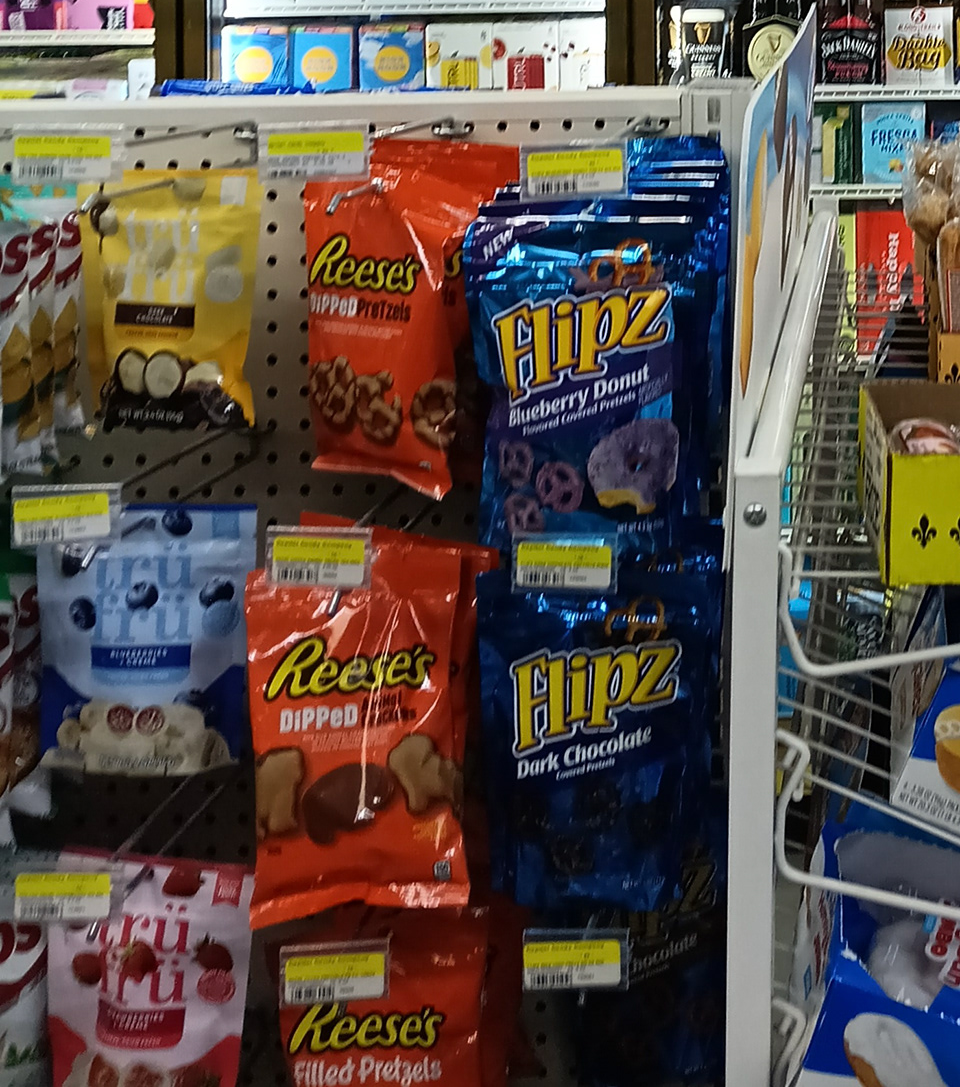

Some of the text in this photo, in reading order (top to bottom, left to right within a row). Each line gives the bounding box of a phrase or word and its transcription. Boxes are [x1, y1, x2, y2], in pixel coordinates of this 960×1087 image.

[870, 127, 918, 147] FRESCA
[309, 233, 421, 294] Reese's
[483, 226, 515, 262] NEW
[492, 284, 672, 404] Flipz
[508, 363, 650, 428] Blueberry Donut
[522, 390, 636, 437] Flavored Covered Pretzels
[264, 634, 435, 702] Reese's
[511, 640, 682, 757] Flipz
[517, 726, 652, 780] Dark Chocolate
[630, 932, 698, 974] hocolate
[289, 1000, 445, 1055] Reese's
[294, 1054, 443, 1087] Filled Pretzels
